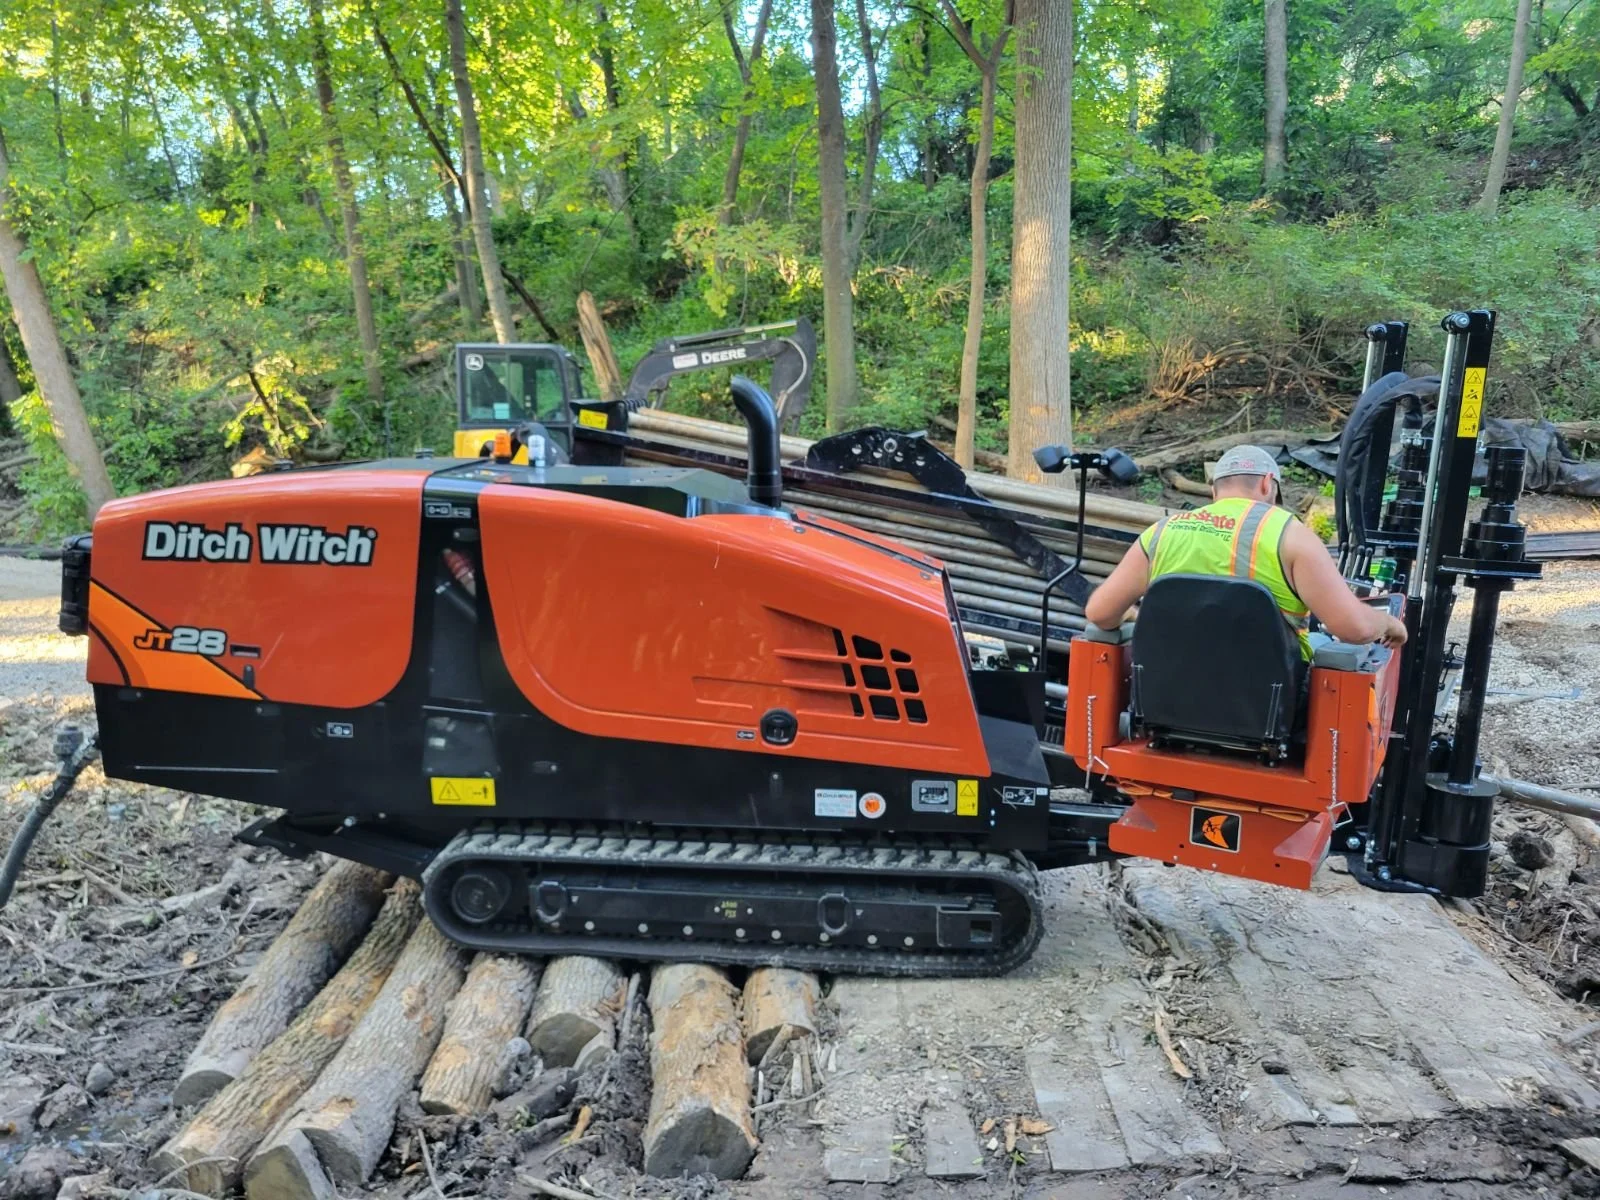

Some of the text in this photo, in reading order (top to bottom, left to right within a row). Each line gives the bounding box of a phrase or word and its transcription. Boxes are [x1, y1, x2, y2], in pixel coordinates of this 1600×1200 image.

[701, 347, 747, 364] DEERE
[144, 522, 374, 564] Ditch Witch
[134, 626, 227, 656] JT28
